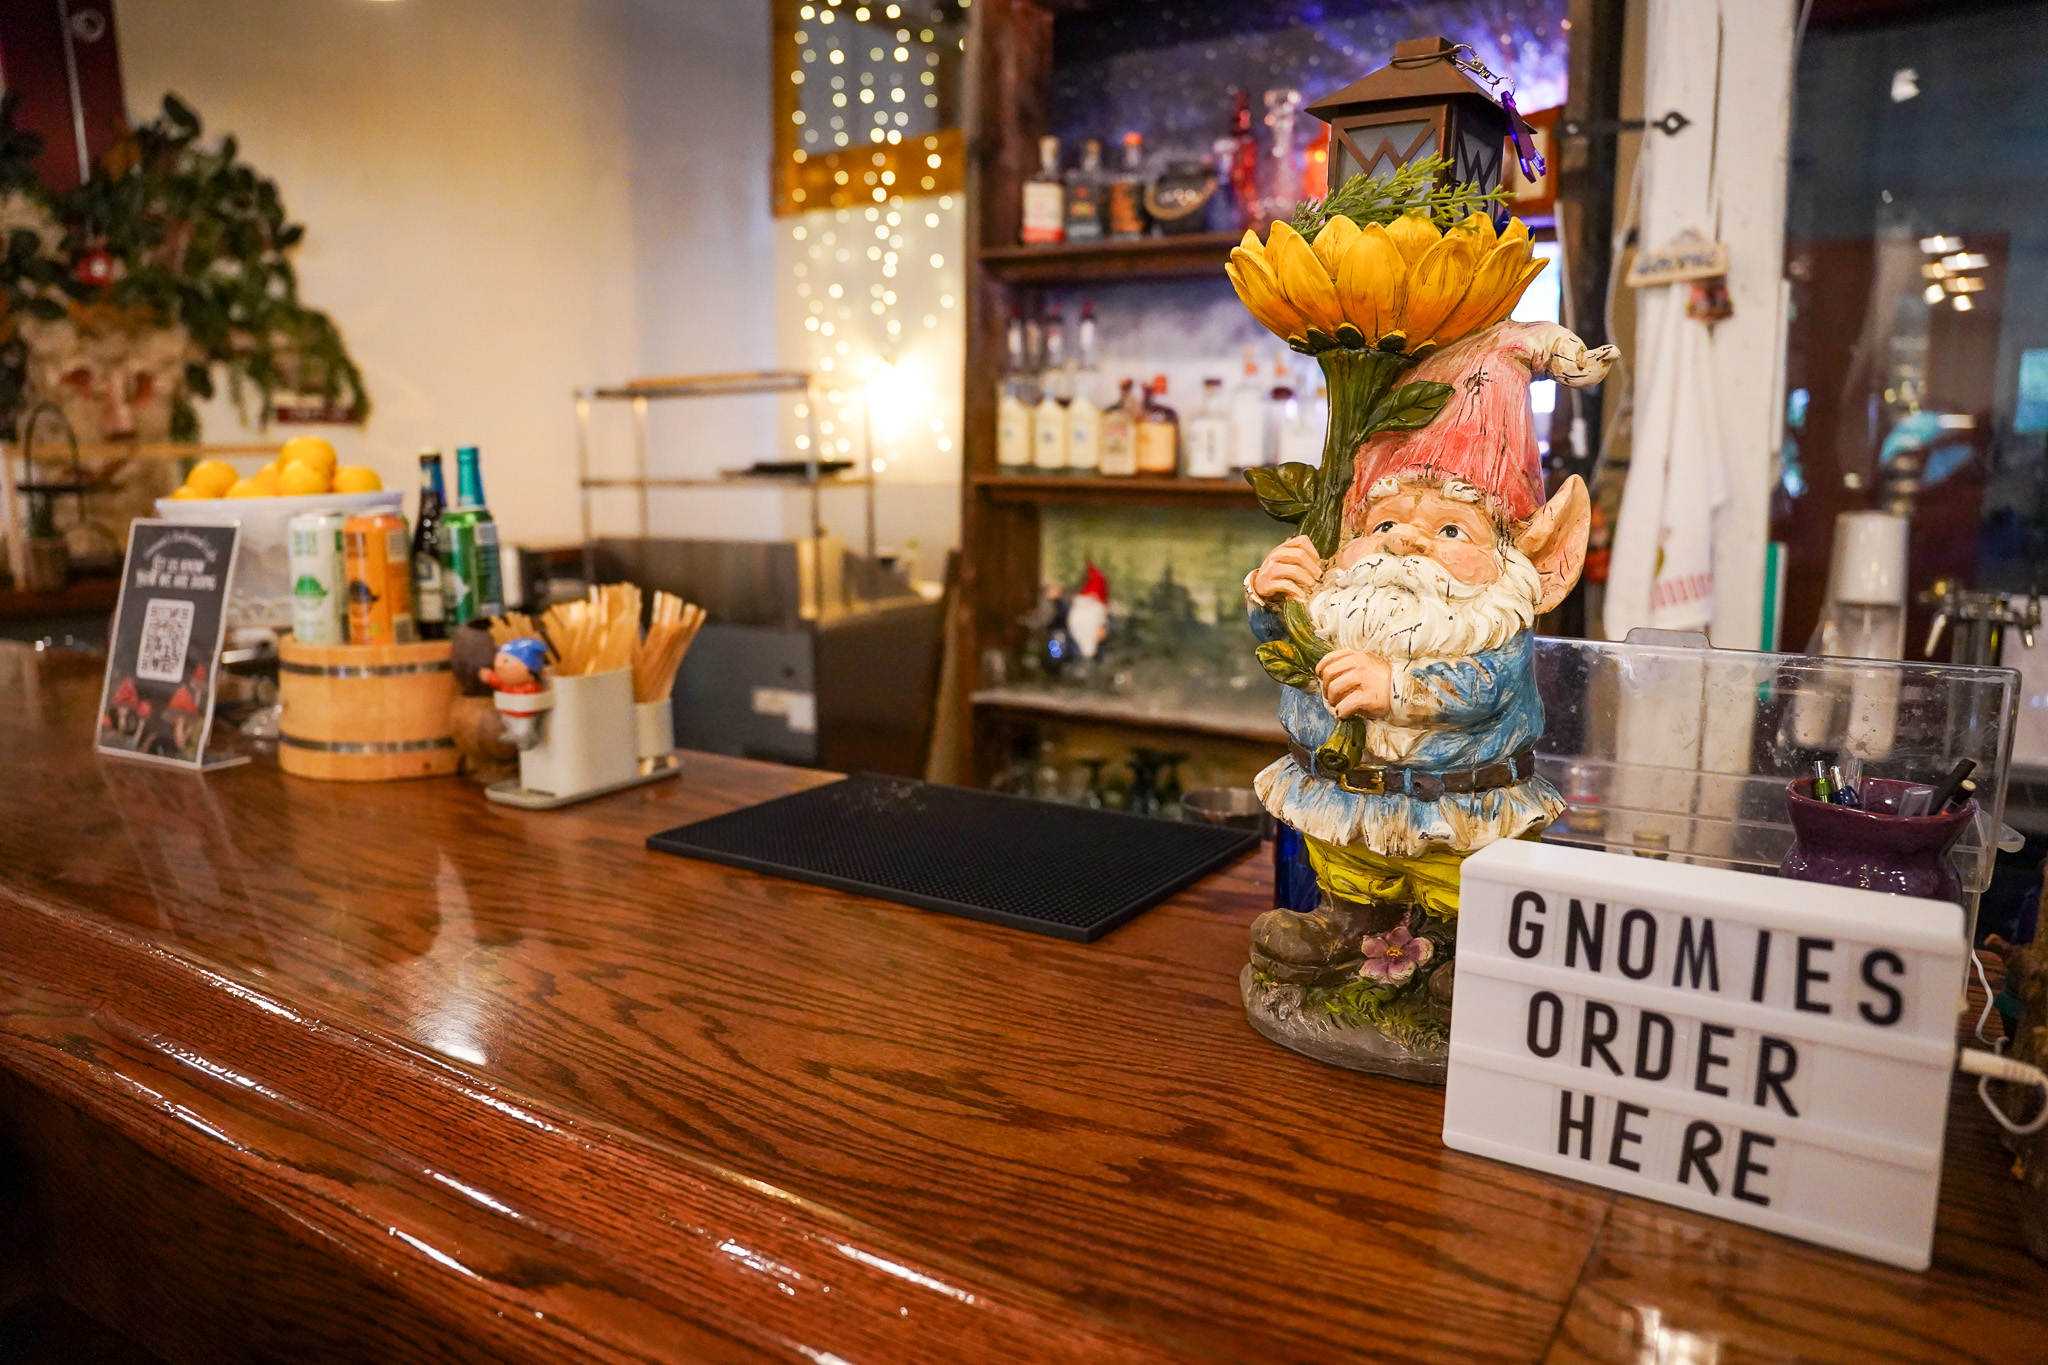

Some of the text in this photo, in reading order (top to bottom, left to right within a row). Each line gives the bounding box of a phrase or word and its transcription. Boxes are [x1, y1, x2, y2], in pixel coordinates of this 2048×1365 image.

[1508, 890, 1907, 1028] GNOMIES
[1526, 990, 1800, 1118] ORDER
[1557, 1089, 1777, 1208] HERE
